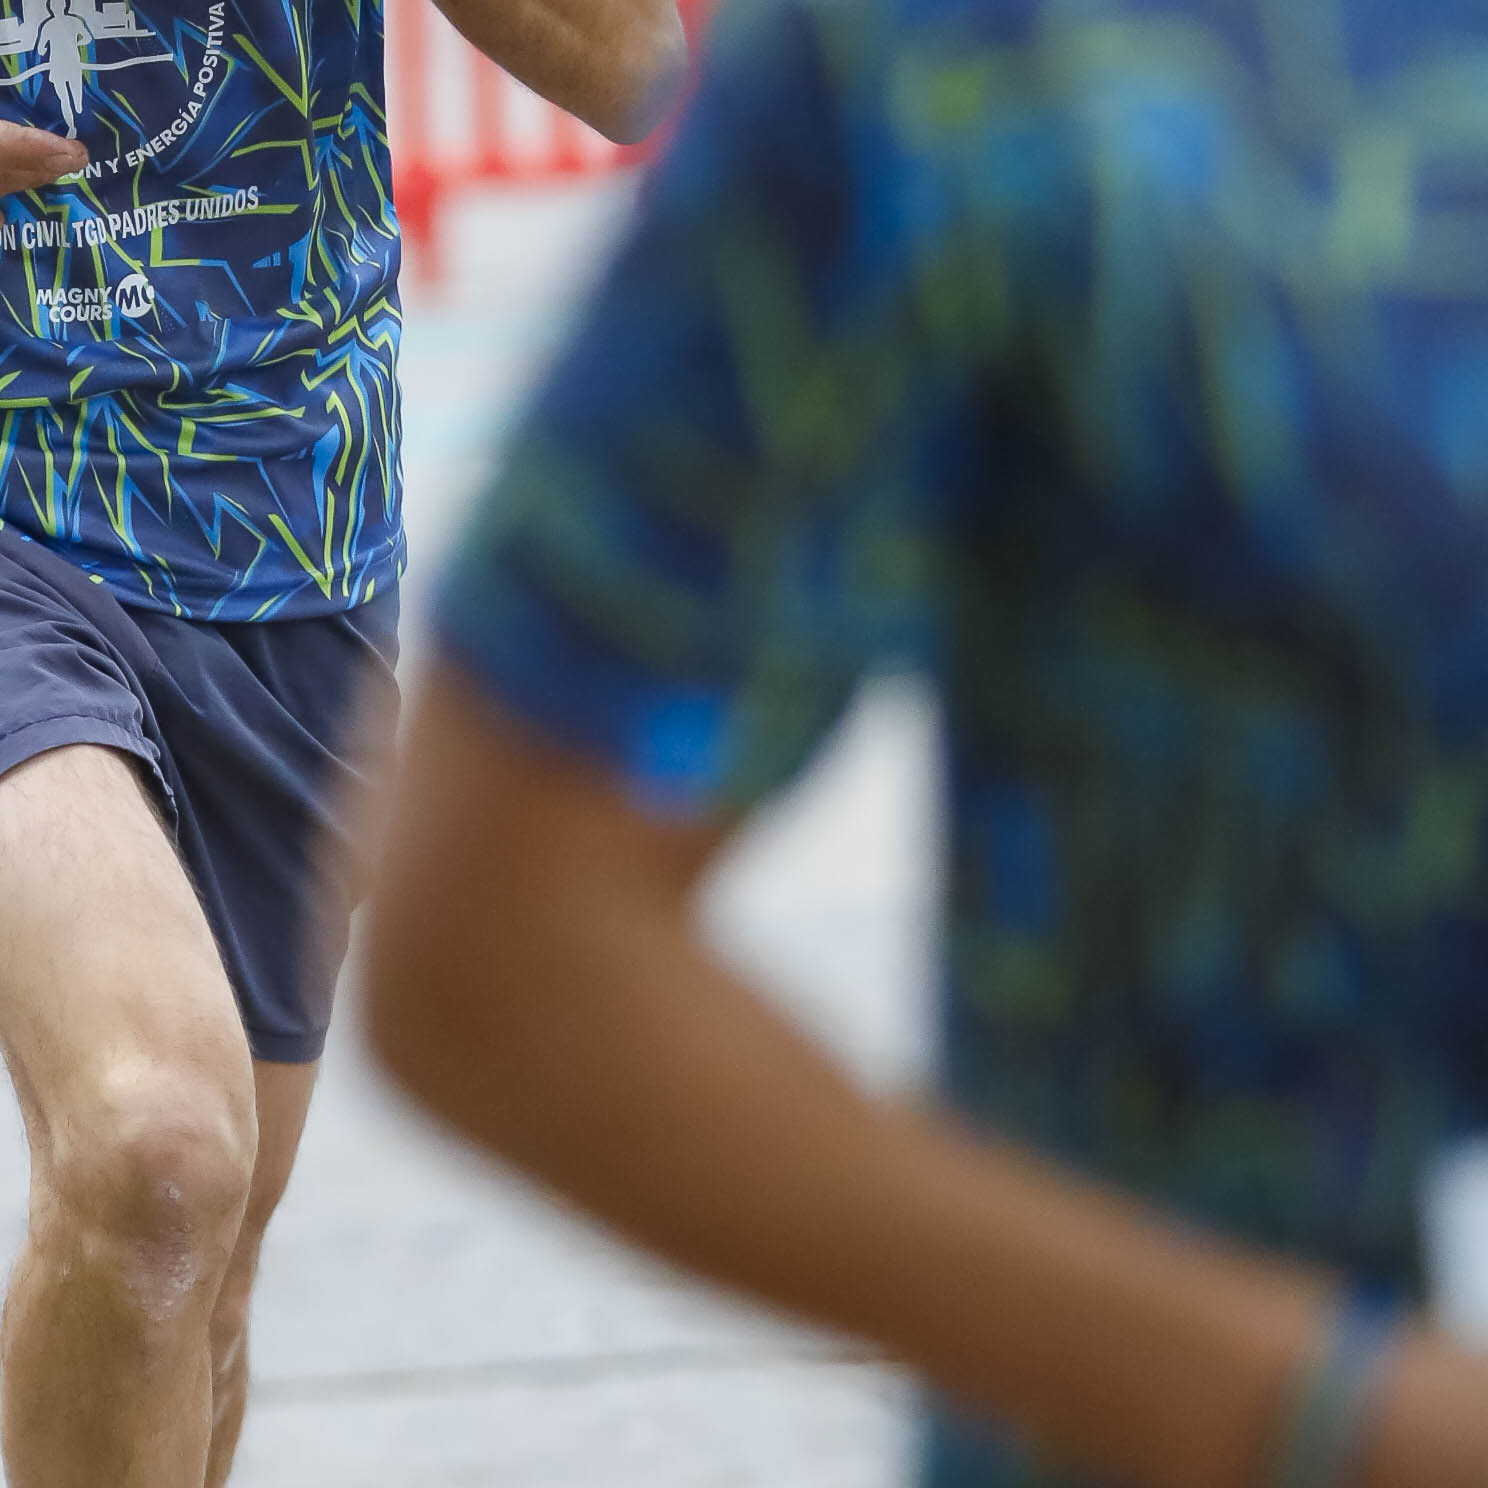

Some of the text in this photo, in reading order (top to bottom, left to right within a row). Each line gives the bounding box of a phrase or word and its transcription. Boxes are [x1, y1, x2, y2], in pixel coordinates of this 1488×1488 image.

[105, 1, 225, 174] Y ENERGÍA POSITIVA
[22, 220, 71, 250] CIVIL
[72, 216, 107, 248] TGD
[107, 199, 180, 241] PADRES
[185, 185, 259, 222] UNIDOS
[36, 286, 112, 306] MAGNY
[49, 300, 113, 323] COURS
